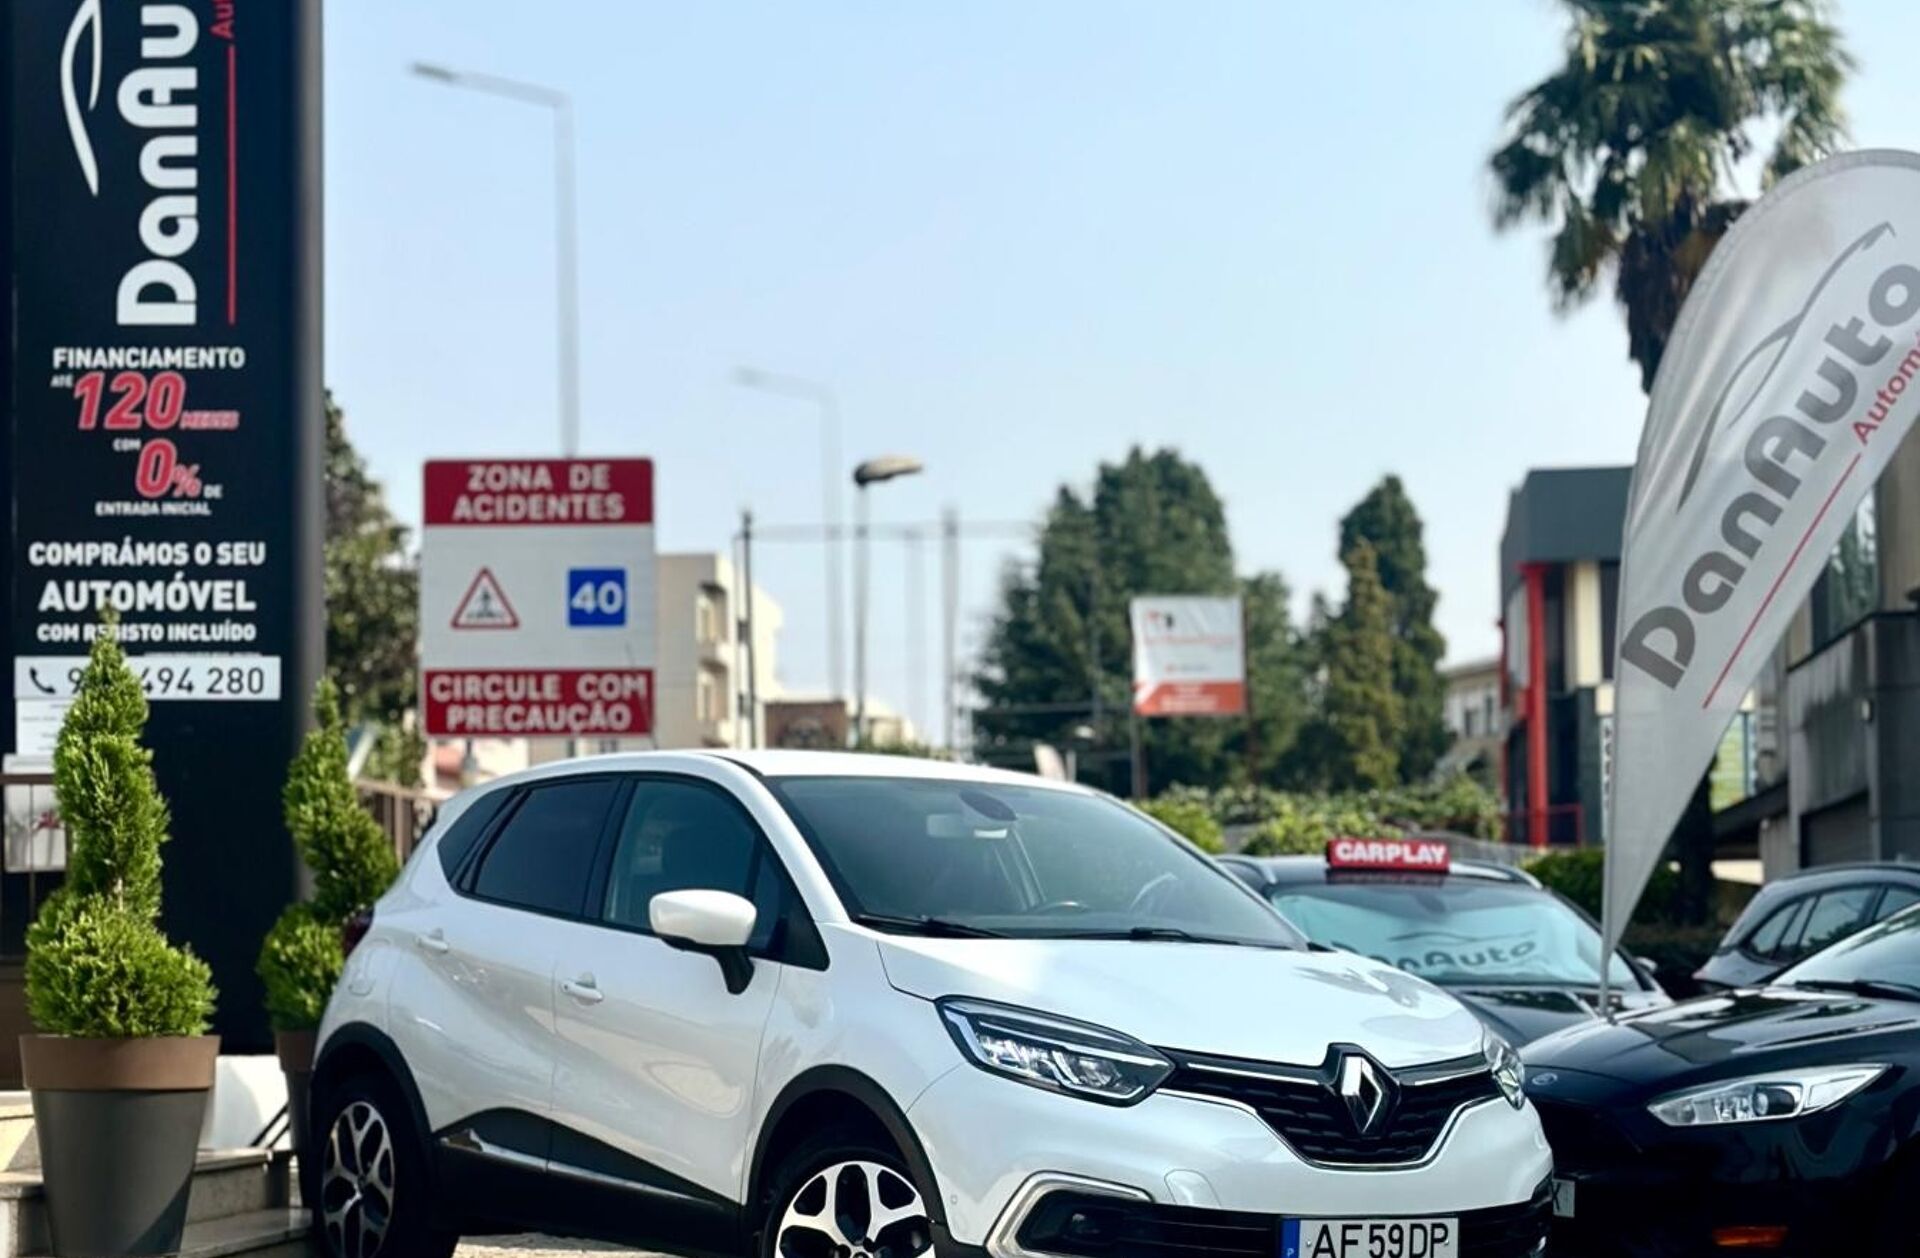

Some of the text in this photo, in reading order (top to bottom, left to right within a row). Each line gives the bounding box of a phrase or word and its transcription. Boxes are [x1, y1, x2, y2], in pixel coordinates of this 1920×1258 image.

[52, 347, 246, 369] FINANCIAMENTO
[51, 375, 74, 388] ATÉ
[74, 371, 186, 430] 120
[1853, 330, 1920, 445] Autom
[113, 438, 223, 498] COM 0% DE
[467, 464, 611, 491] ZONA DE
[1621, 264, 1920, 689] DanAuto
[95, 502, 212, 516] ENTRADA INICIAL
[453, 494, 626, 521] ACIDENTES
[28, 536, 266, 567] COMPRÁMOS O SEU
[38, 571, 257, 612] AUTOMÓVEL
[571, 581, 623, 615] 40
[37, 622, 79, 642] COM
[168, 618, 257, 642] INCLUÍDO
[206, 667, 265, 694] 280
[430, 674, 648, 701] CIRCULE COM
[446, 701, 632, 736] PRECAUÇÃO
[1335, 842, 1446, 865] CARPLAY
